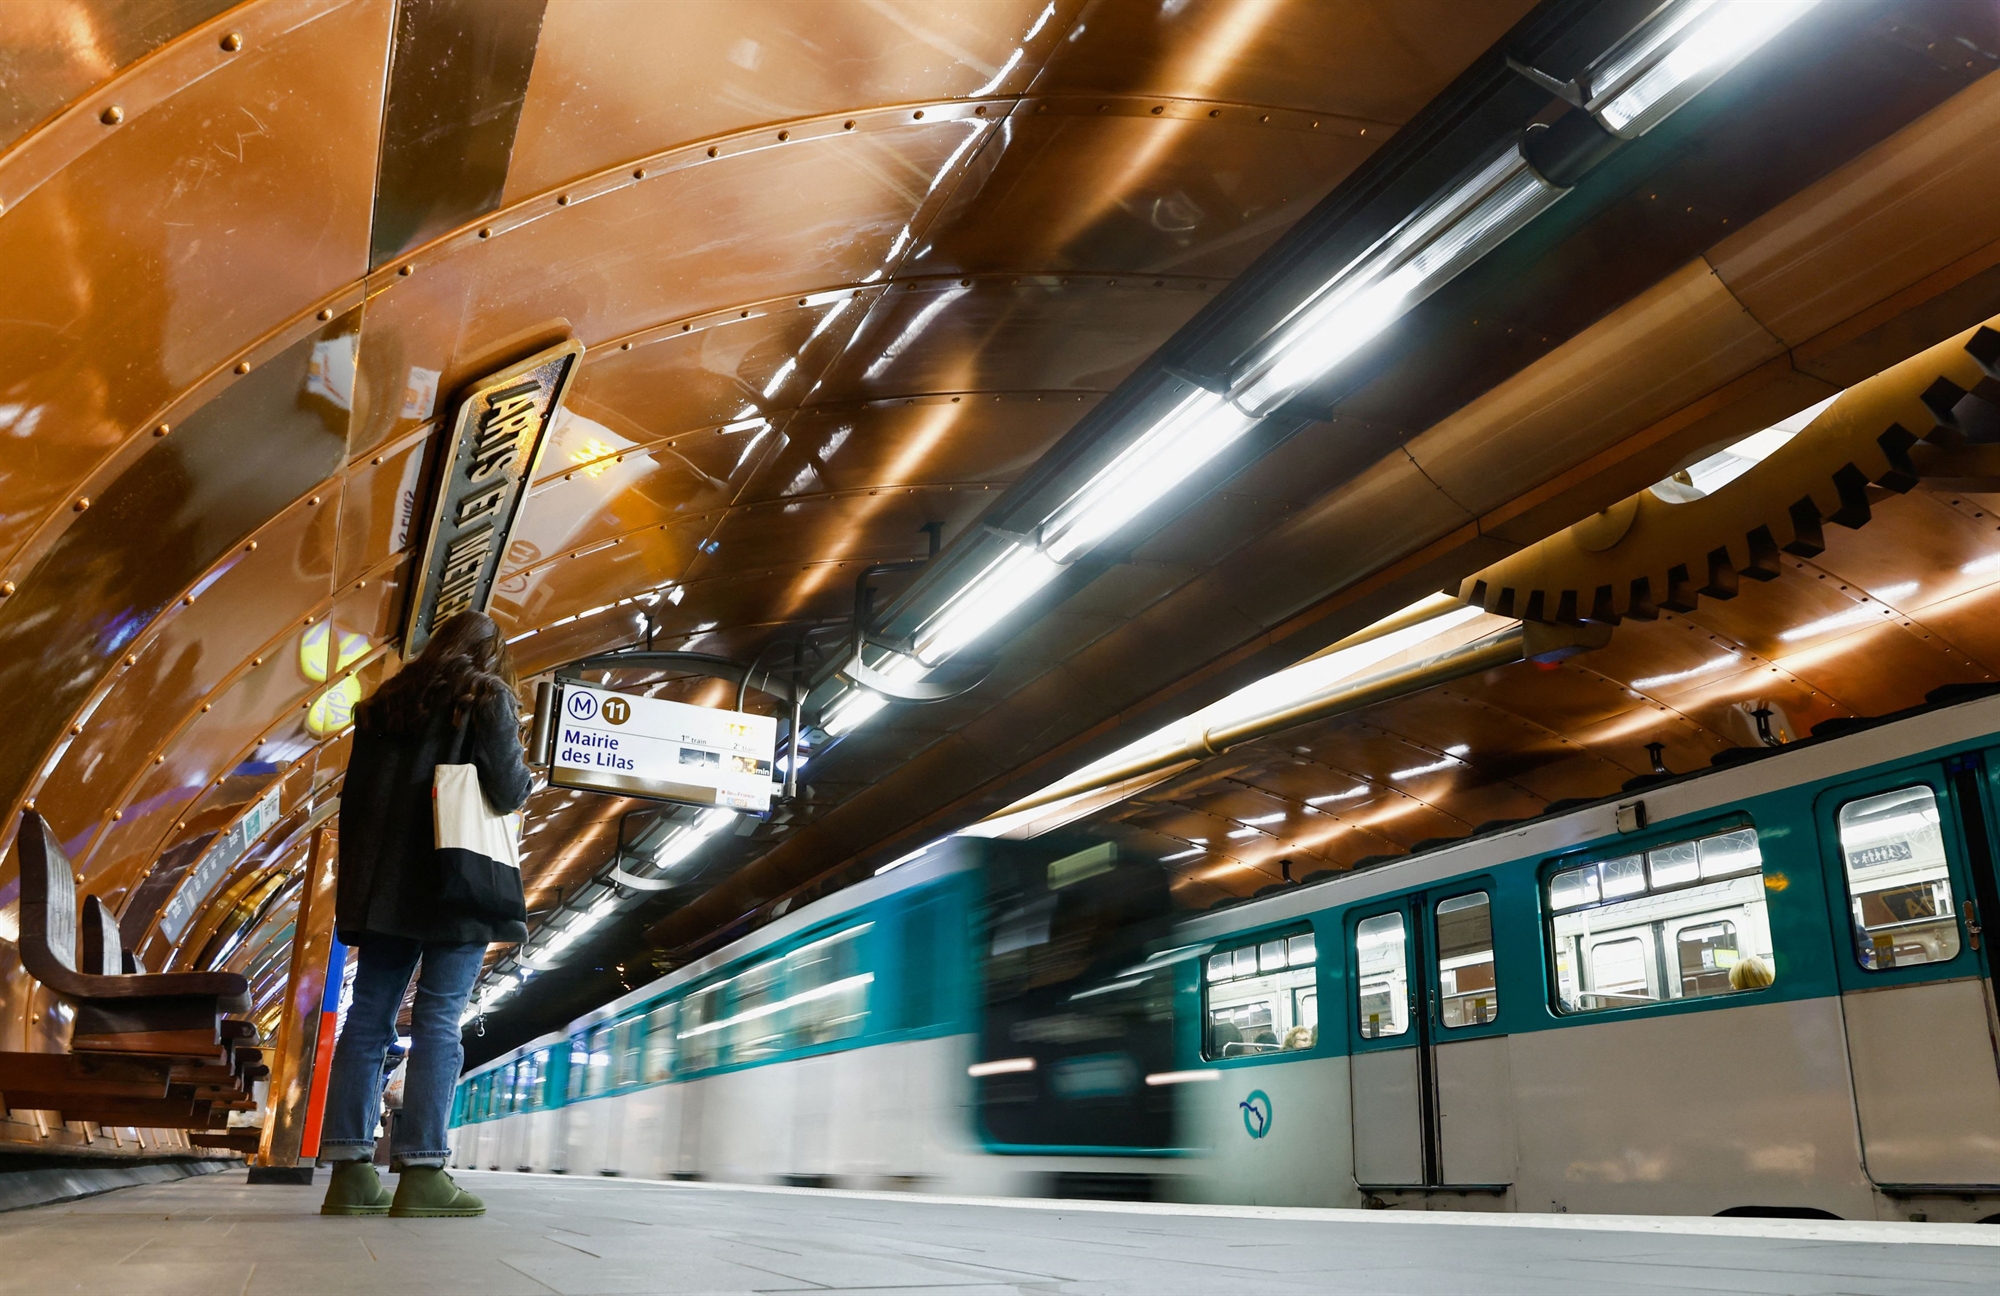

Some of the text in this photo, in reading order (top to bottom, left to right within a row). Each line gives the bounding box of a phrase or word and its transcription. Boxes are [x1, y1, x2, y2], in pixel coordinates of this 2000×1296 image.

[471, 384, 541, 484] ARTS
[456, 478, 509, 530] ET
[574, 697, 625, 720] M 11
[564, 729, 619, 750] Mairie
[691, 737, 707, 745] train
[561, 747, 634, 770] des Lilas
[756, 768, 770, 776] min
